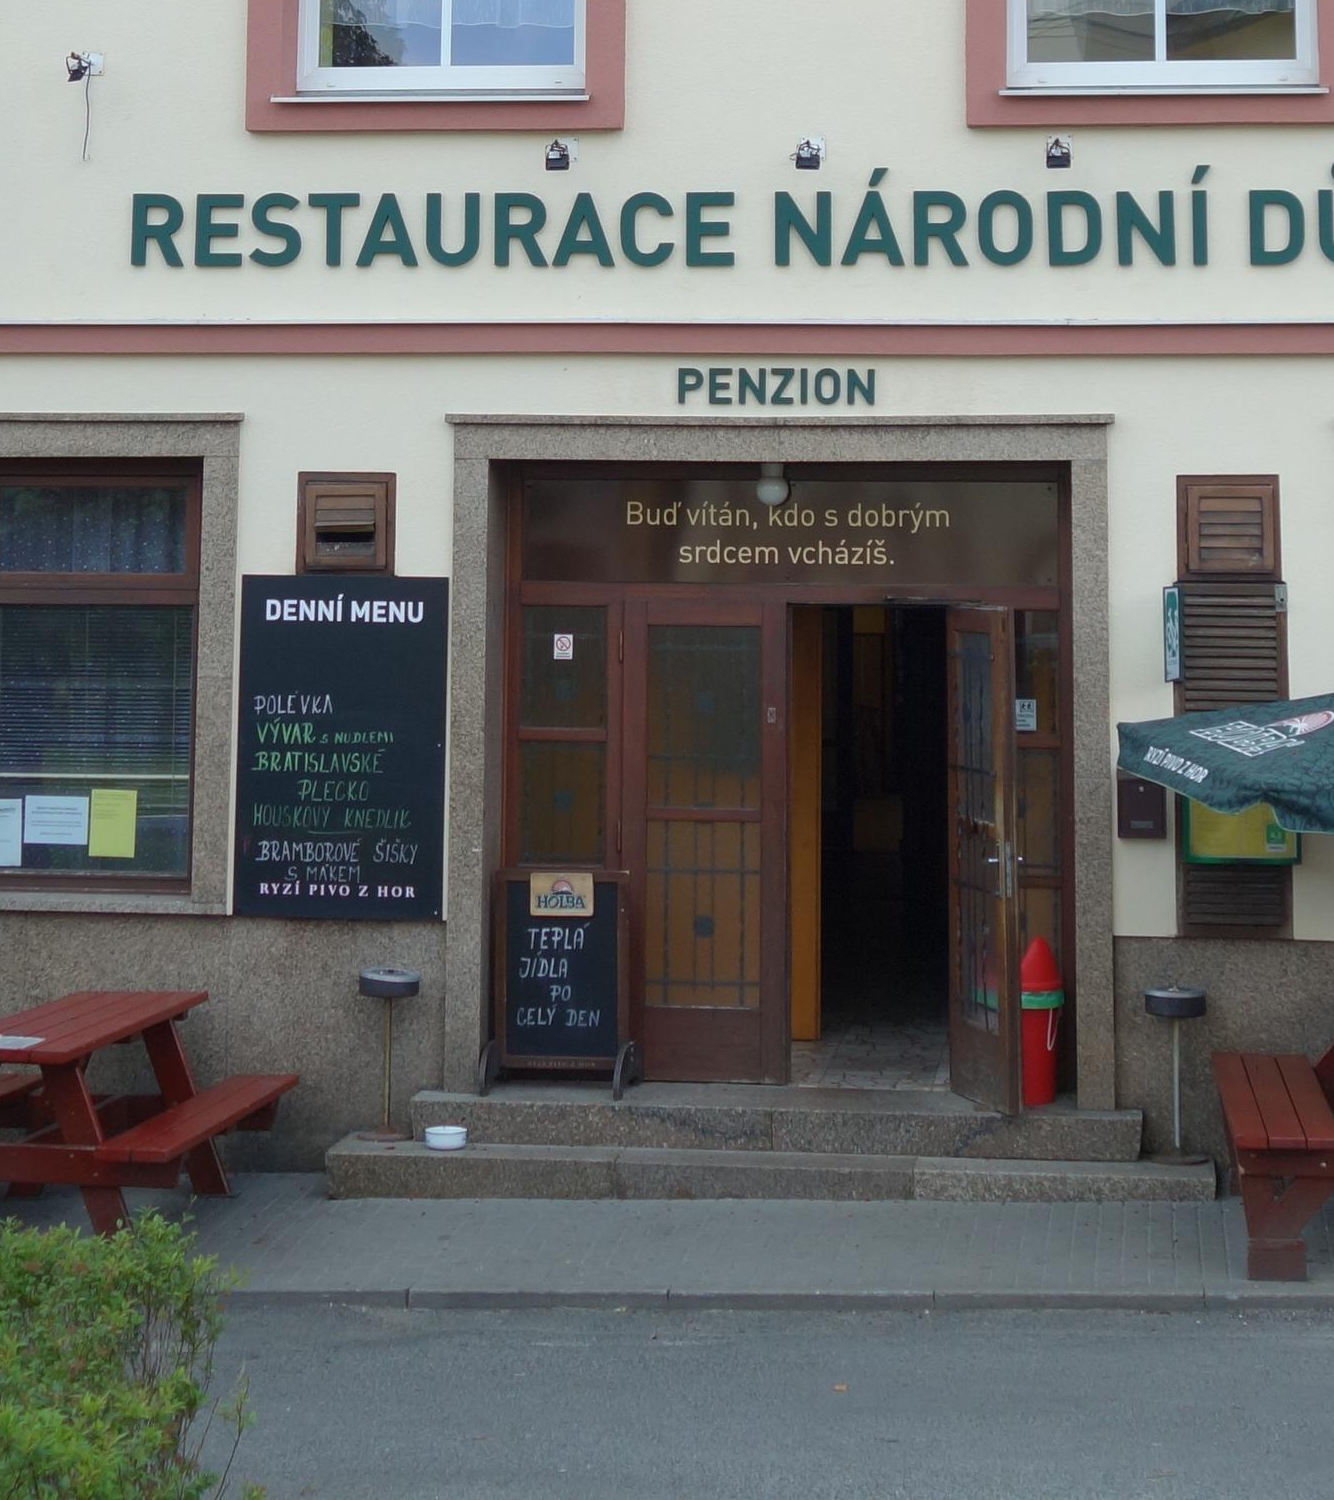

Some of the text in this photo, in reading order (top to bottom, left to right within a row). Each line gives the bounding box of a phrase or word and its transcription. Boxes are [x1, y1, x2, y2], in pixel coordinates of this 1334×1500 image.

[131, 192, 735, 267] RESTAURACE
[774, 165, 1210, 267] NÁRODNÍ
[676, 367, 877, 407] PENZION
[626, 501, 950, 533] Buď vítán, kdo s dobrým
[679, 540, 896, 565] srdcem vcházíš.
[265, 593, 424, 623] DENNÍ MENU
[256, 716, 316, 745] VÝVAR
[334, 731, 394, 744] NUDLEMI
[251, 749, 386, 774] BRATISLAVSKÉ
[255, 837, 419, 865] BRAMBOROVÉ ŠIŠKY
[259, 880, 416, 899] RYZÍ PIVO Z HOR
[527, 922, 590, 950] TEPLÁ
[519, 951, 569, 979] JÍDLA
[549, 985, 572, 1002] PO
[516, 1003, 601, 1027] CELÝ DEN
